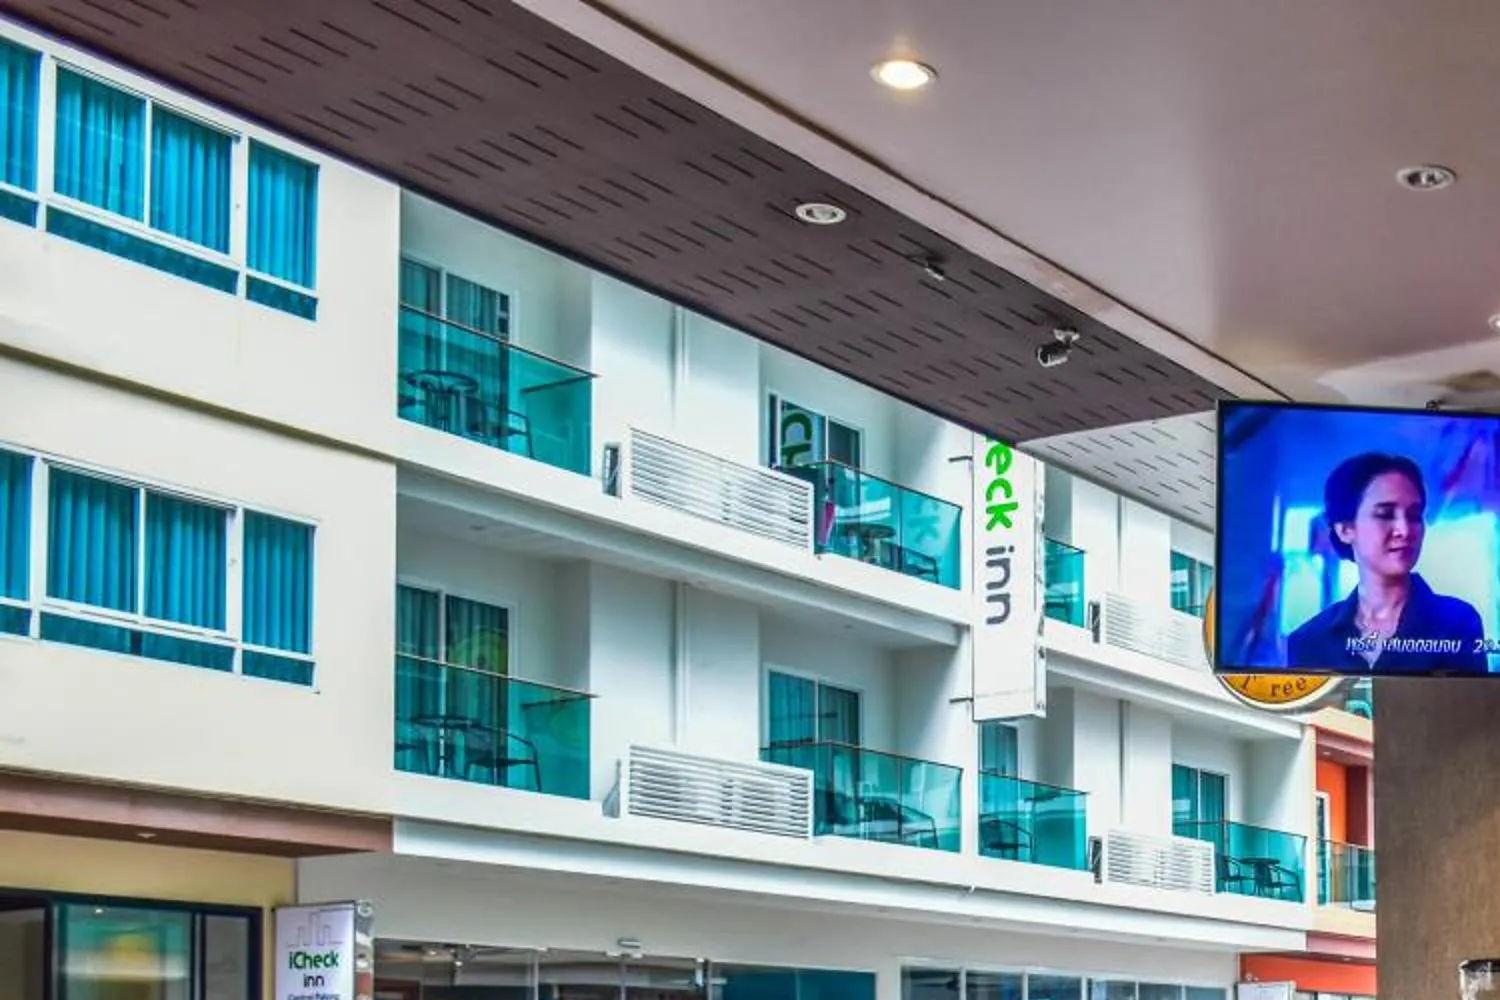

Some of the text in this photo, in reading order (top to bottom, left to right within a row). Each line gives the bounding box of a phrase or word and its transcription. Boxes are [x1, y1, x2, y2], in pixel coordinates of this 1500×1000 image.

[985, 437, 1018, 625] eck inn
[288, 949, 339, 970] iCheck
[303, 974, 325, 988] inn
